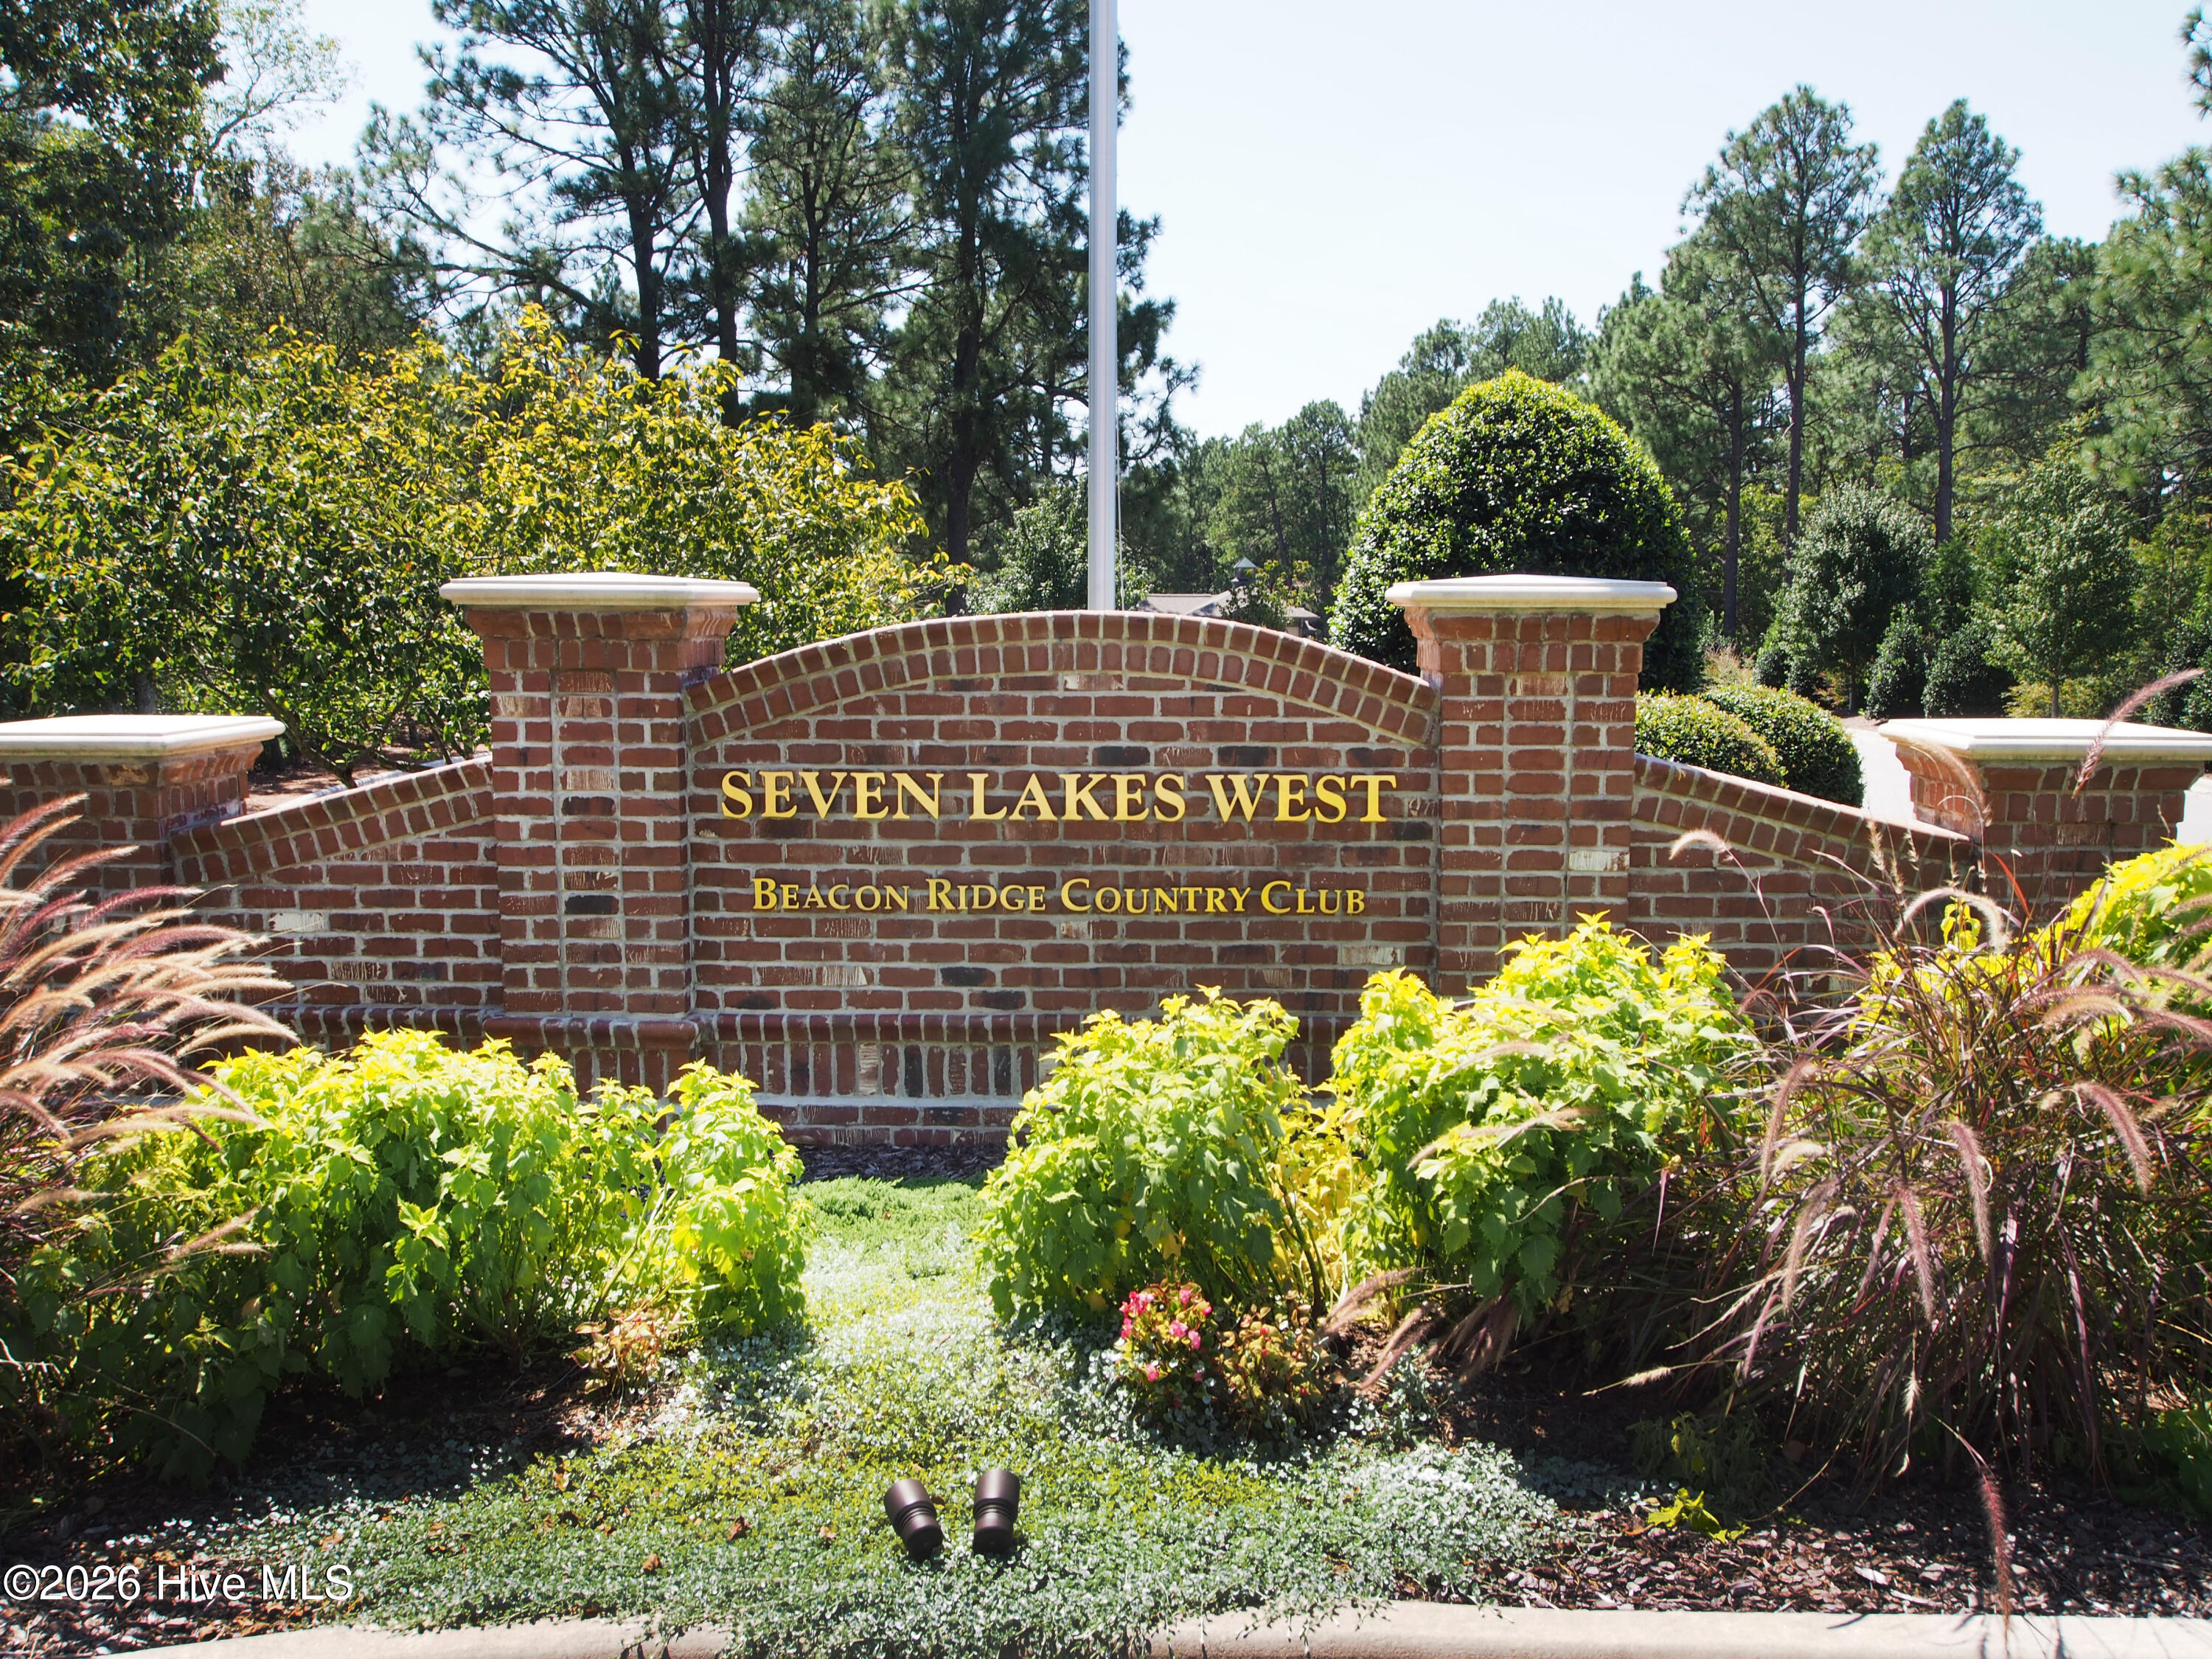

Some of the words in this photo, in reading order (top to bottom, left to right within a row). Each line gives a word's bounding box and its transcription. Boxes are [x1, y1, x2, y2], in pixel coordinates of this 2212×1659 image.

[720, 771, 945, 819] SEVEN
[967, 772, 1186, 822] LAKES
[1205, 773, 1397, 824] WEST
[751, 877, 910, 911] BEACON
[925, 878, 1046, 911] RIDGE
[1060, 877, 1251, 914] COUNTRY
[1261, 880, 1366, 915] CLUB
